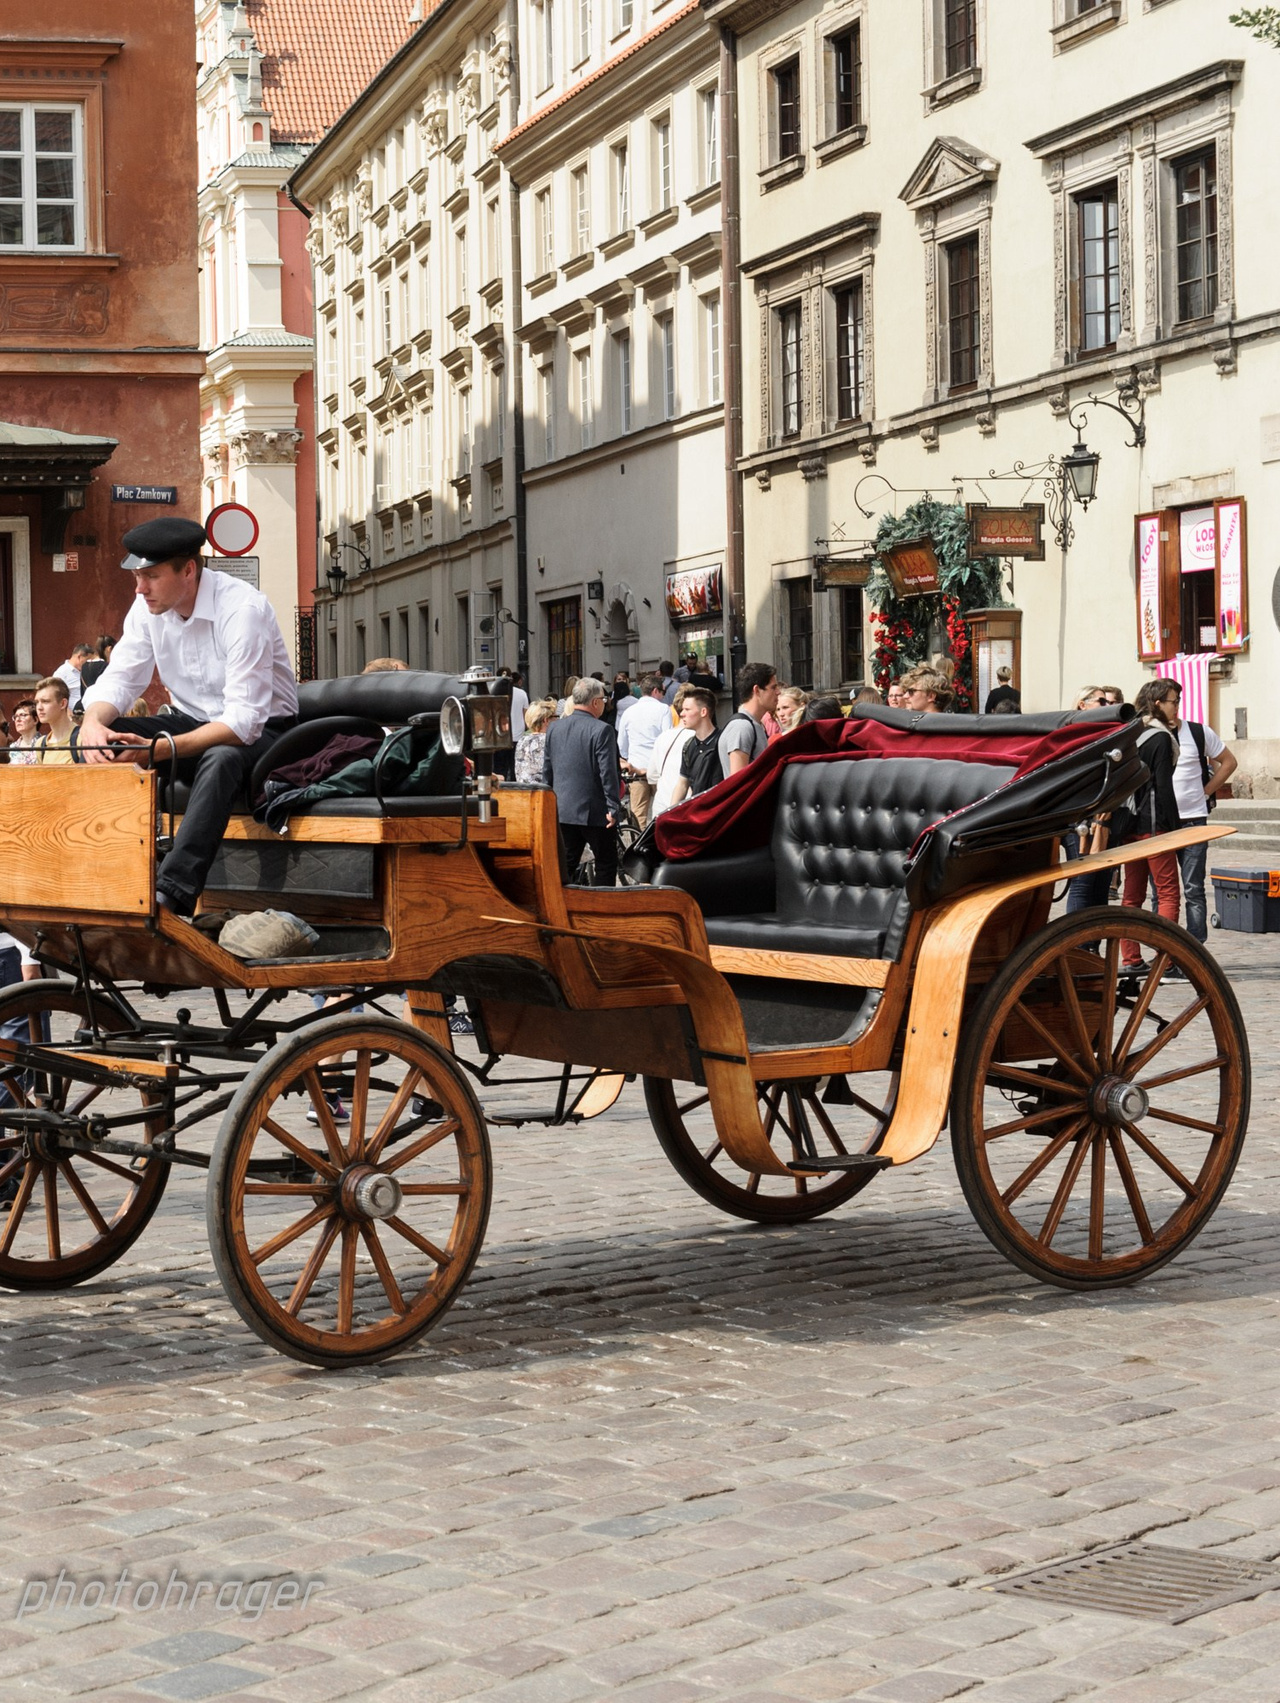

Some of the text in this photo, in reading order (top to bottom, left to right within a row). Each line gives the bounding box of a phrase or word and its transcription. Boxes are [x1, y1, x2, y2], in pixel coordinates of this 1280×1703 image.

[116, 486, 172, 503] Plac Zamkowy
[981, 518, 1030, 535] POLKA
[1196, 528, 1215, 542] LOD
[1222, 512, 1238, 558] GRANITA
[981, 536, 1004, 544] Magda
[1142, 525, 1157, 563] LODY
